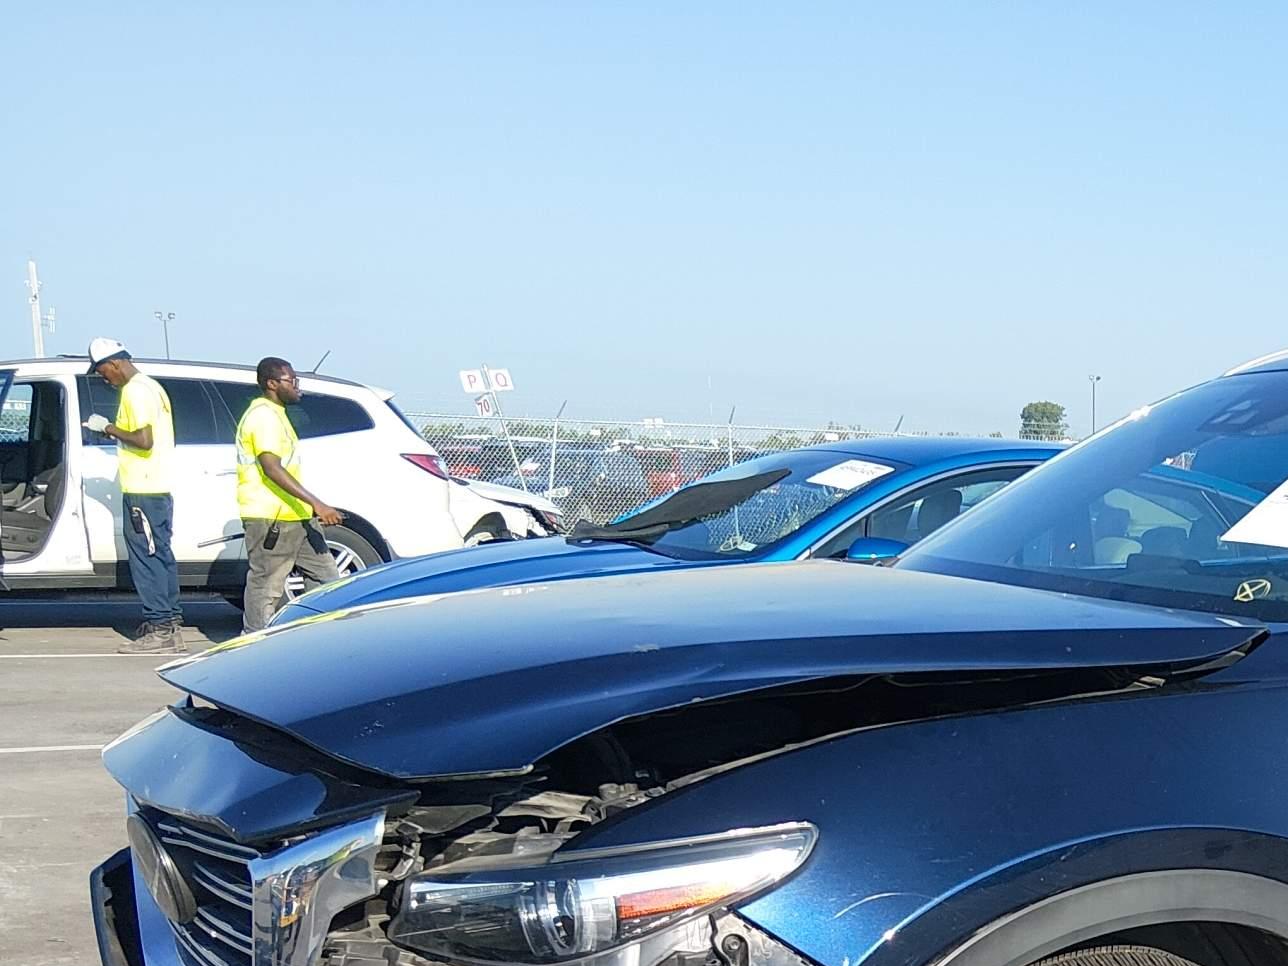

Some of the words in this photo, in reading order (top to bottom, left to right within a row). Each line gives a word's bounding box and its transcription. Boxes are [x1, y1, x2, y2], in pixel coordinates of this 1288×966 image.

[466, 374, 477, 389] P
[495, 373, 508, 388] Q
[476, 399, 490, 416] 70
